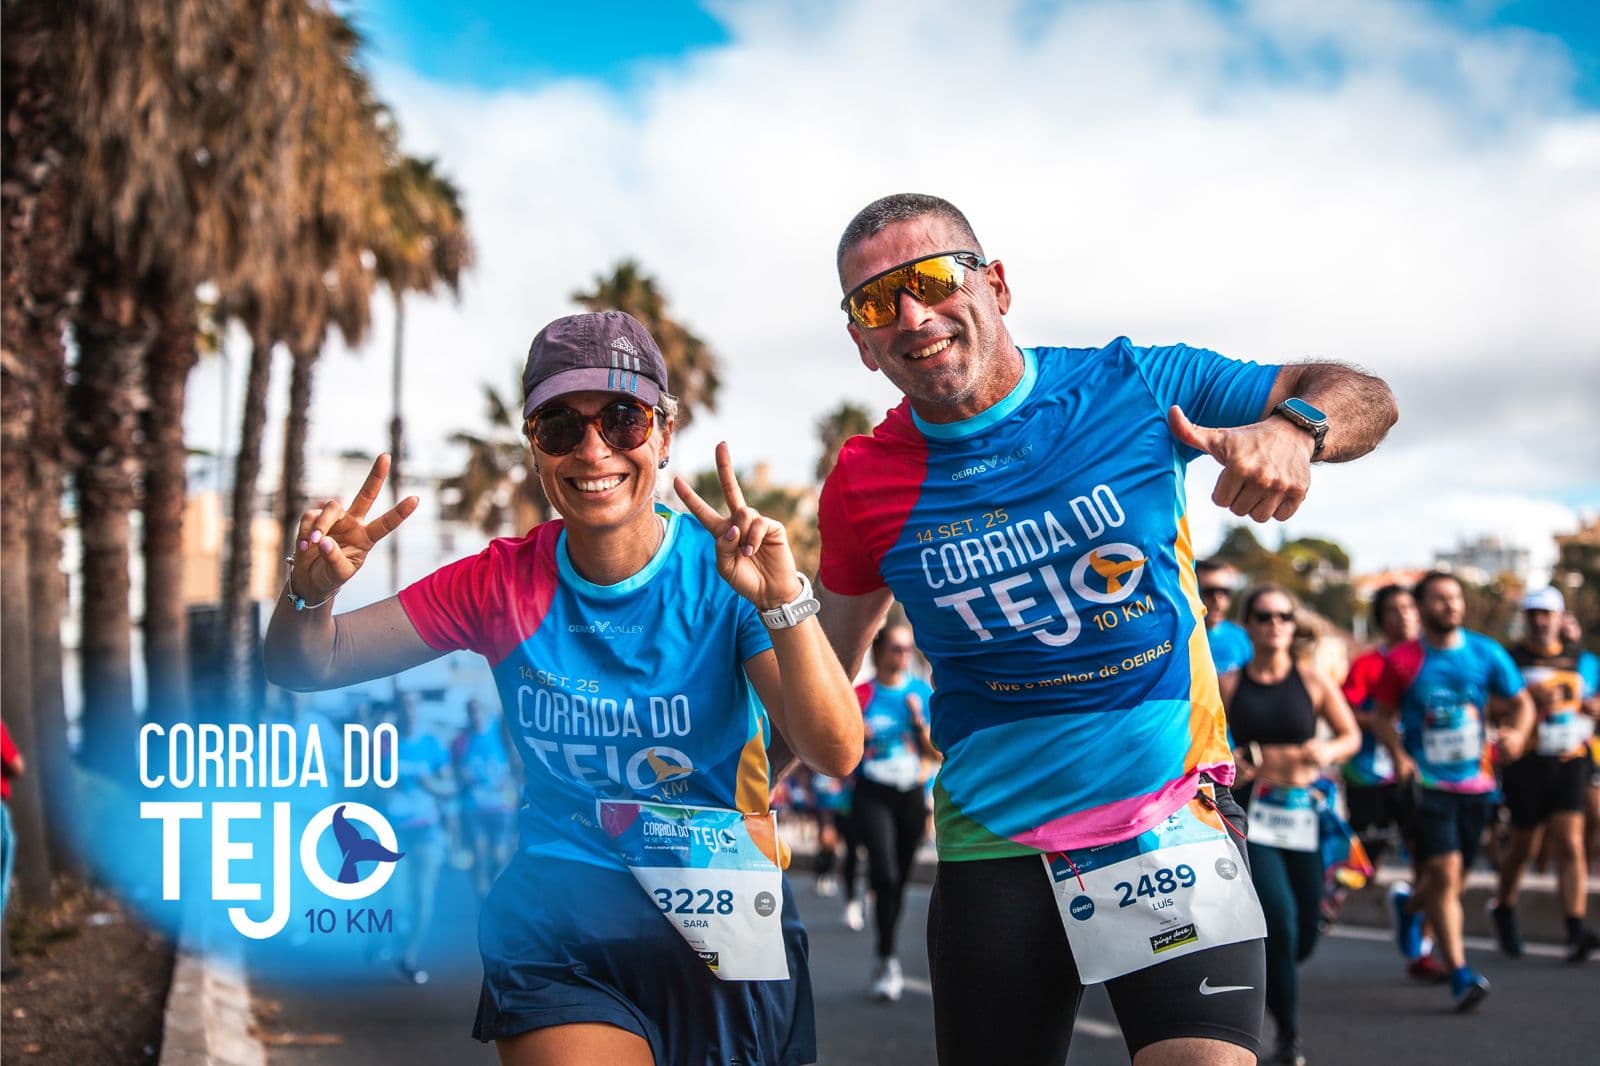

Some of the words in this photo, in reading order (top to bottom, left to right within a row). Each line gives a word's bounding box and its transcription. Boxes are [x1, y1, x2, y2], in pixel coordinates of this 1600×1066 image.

[951, 464, 987, 481] OEIRAS
[1000, 443, 1033, 465] VALLEY
[916, 529, 934, 545] 14
[938, 518, 979, 541] SET.
[982, 508, 1010, 530] 25
[920, 510, 1077, 590] CORRIDA
[1069, 483, 1126, 540] DO
[934, 542, 1146, 647] TEJO
[1092, 610, 1119, 631] 10
[1122, 594, 1156, 623] KM
[519, 665, 534, 681] 14
[535, 670, 571, 690] SET.
[576, 679, 600, 694] 25
[985, 680, 1021, 692] Vive
[1038, 671, 1095, 688] melhor
[1099, 665, 1120, 679] de
[1121, 639, 1173, 671] OEIRAS
[517, 685, 643, 738] CORRIDA
[649, 694, 692, 738] DO
[661, 780, 690, 801] KM
[643, 821, 677, 837] CORRIDA
[677, 825, 690, 838] DO
[689, 826, 737, 853] TEJO
[652, 888, 734, 916] 3228
[1114, 864, 1197, 909] 2489
[1152, 897, 1175, 912] LUÍS
[683, 919, 710, 929] SARA
[1153, 936, 1172, 949] pingo
